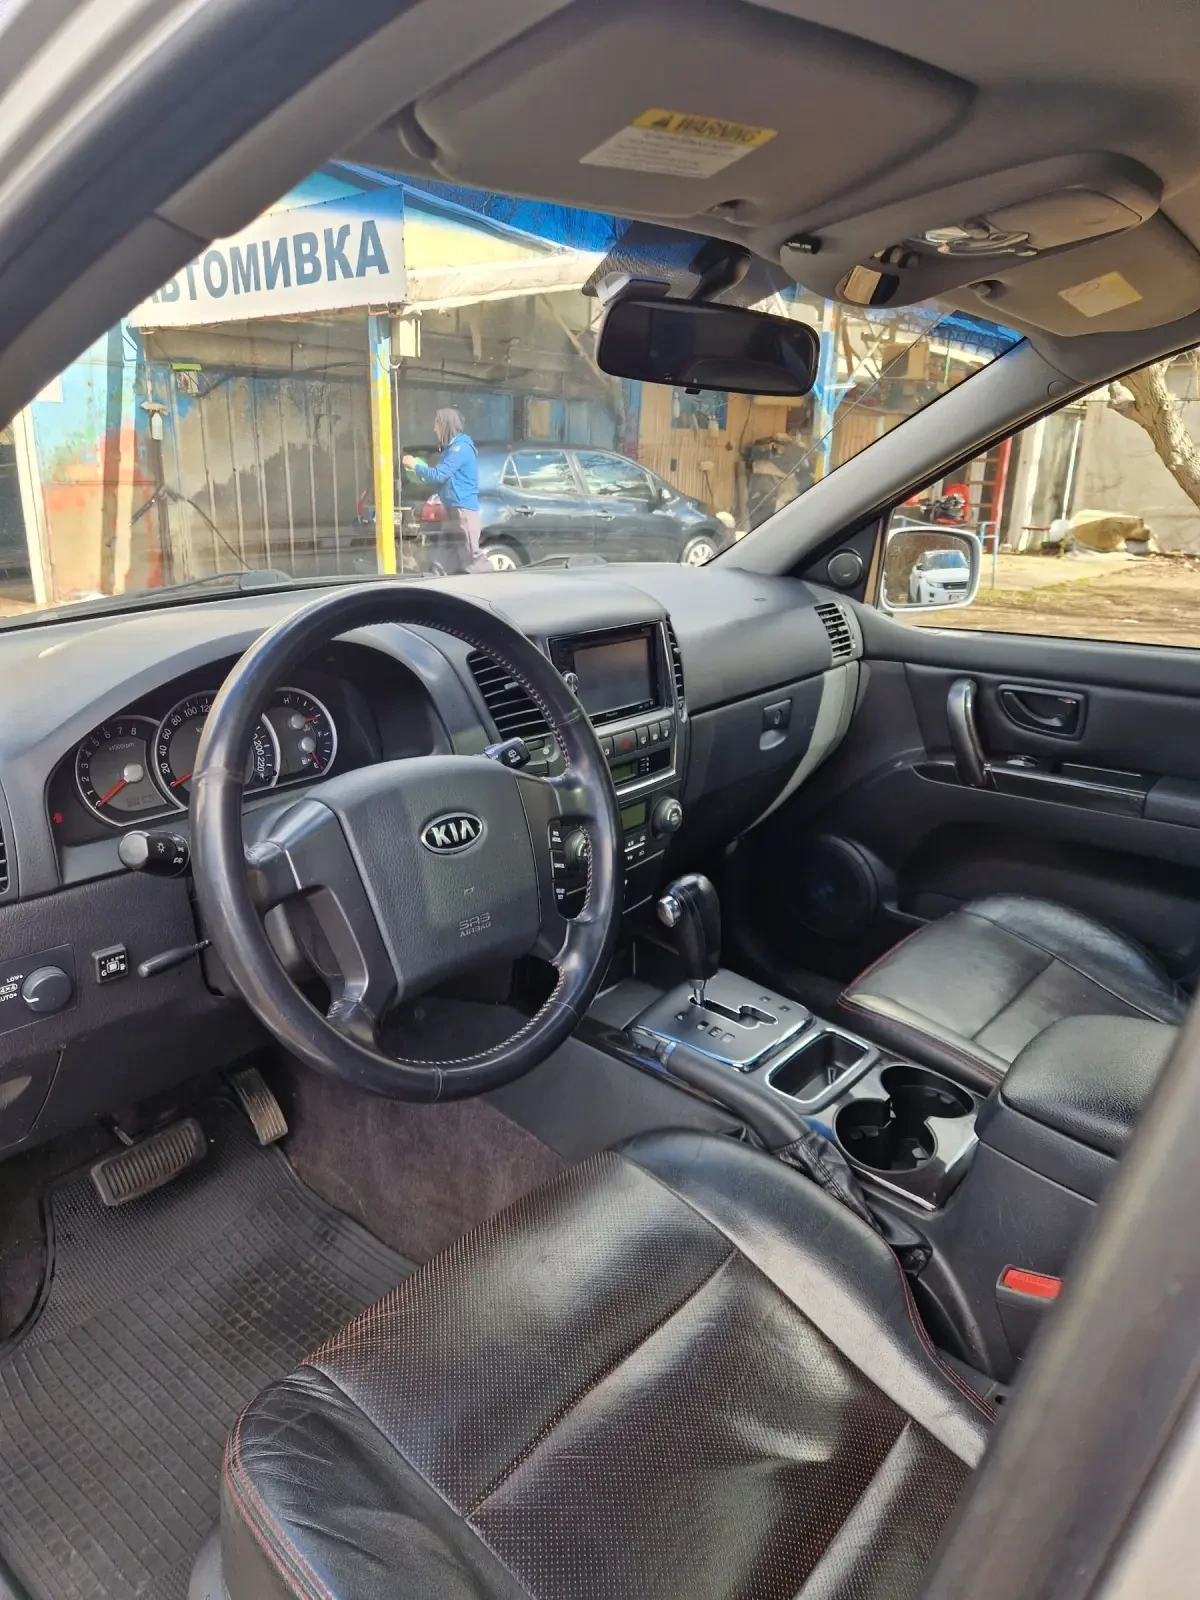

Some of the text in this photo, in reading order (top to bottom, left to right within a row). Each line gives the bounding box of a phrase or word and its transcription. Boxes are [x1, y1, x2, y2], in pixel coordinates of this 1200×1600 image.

[151, 219, 390, 304] ВТОМИВКА
[184, 706, 197, 717] 100
[171, 715, 182, 726] 80
[162, 728, 171, 740] 60
[159, 745, 167, 757] 40
[253, 740, 265, 756] 200
[160, 762, 170, 774] 20
[257, 757, 265, 772] 220
[431, 819, 476, 847] KIA
[0, 993, 14, 1002] UTO
